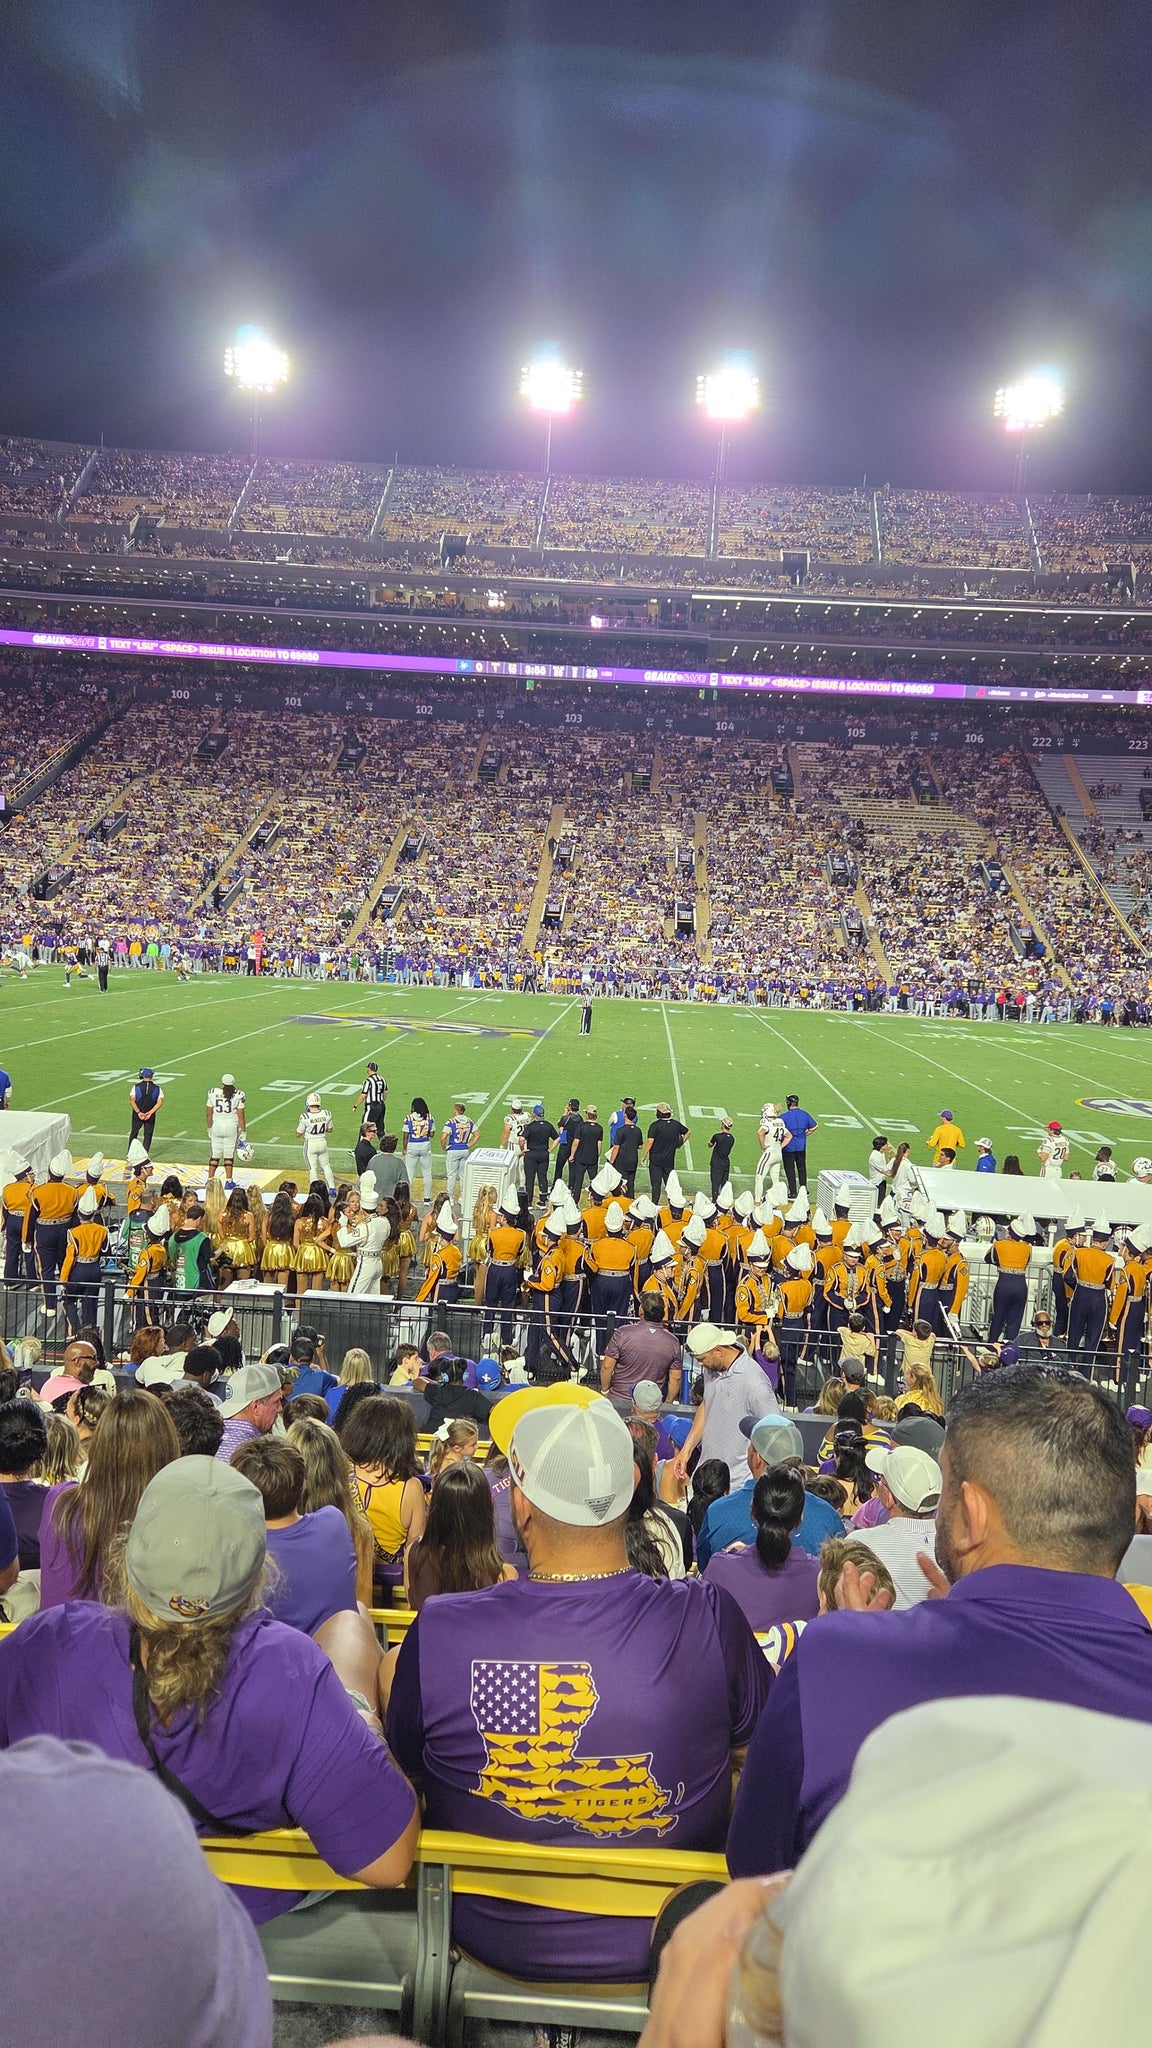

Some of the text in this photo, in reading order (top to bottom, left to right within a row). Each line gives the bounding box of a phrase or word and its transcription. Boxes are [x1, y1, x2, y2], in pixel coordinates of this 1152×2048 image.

[110, 640, 131, 649] TEXT
[199, 645, 225, 655] ISSUE
[234, 648, 276, 658] LOCATION
[277, 650, 289, 659] TO
[721, 675, 743, 685] TEXT
[811, 680, 838, 690] ISSUE
[846, 682, 890, 692] LOCATION
[891, 683, 903, 693] TO
[171, 690, 189, 700] 100
[284, 696, 302, 707] 101
[415, 705, 433, 715] 102
[565, 713, 583, 723] 103
[715, 721, 734, 731] 104
[847, 728, 866, 738] 105
[965, 733, 984, 743] 106
[1032, 737, 1052, 747] 222
[1128, 740, 1149, 750] 223
[215, 1099, 232, 1113] 53
[310, 1123, 326, 1135] 44
[517, 1125, 527, 1137] 2
[1053, 1147, 1067, 1160] 20
[492, 1476, 511, 1493] TIG
[574, 1797, 648, 1807] TIGERS
